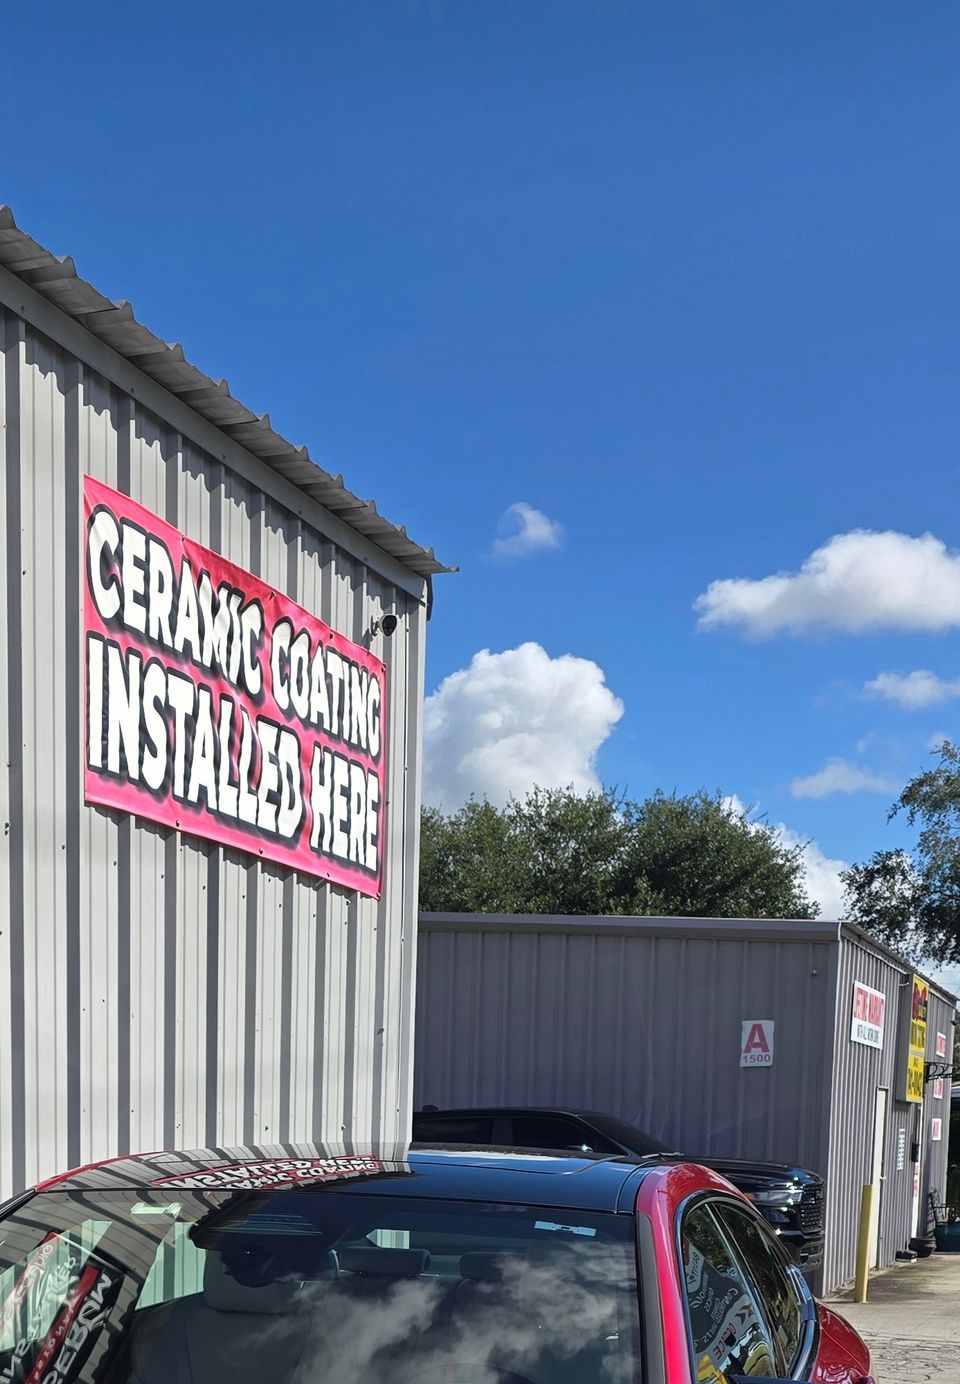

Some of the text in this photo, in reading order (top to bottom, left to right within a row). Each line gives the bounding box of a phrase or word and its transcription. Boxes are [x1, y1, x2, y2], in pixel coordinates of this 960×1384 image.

[87, 506, 382, 758] CERAMIC COATING
[86, 633, 380, 876] INSTALLED HERE
[742, 1053, 771, 1064] 1500
[743, 1023, 770, 1054] A
